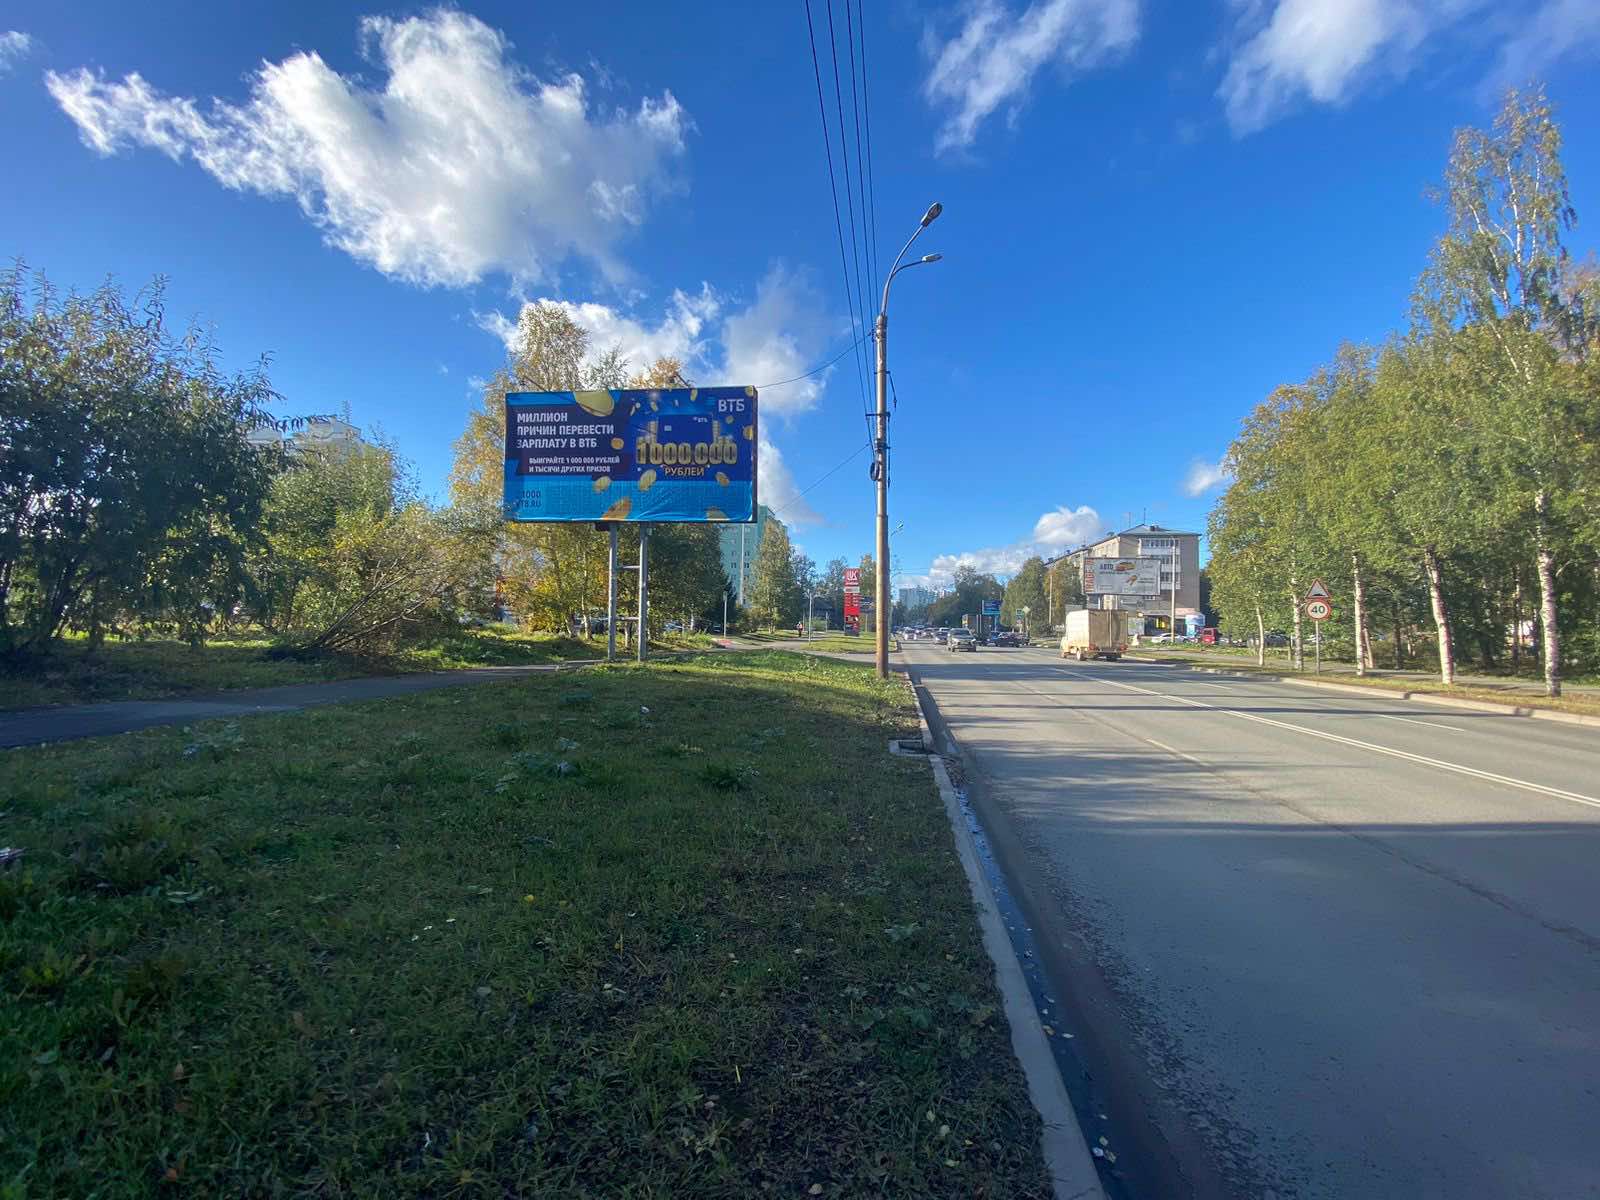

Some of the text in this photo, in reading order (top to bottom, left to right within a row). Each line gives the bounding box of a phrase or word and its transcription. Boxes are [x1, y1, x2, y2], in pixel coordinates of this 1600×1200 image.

[718, 398, 744, 412] ВТБ
[516, 412, 568, 422] МИЛЛИОН
[516, 424, 614, 436] ПРИЧИН ПЕРЕВЕСТИ
[516, 438, 598, 448] ЗАРПЛАТУ В ВТБ
